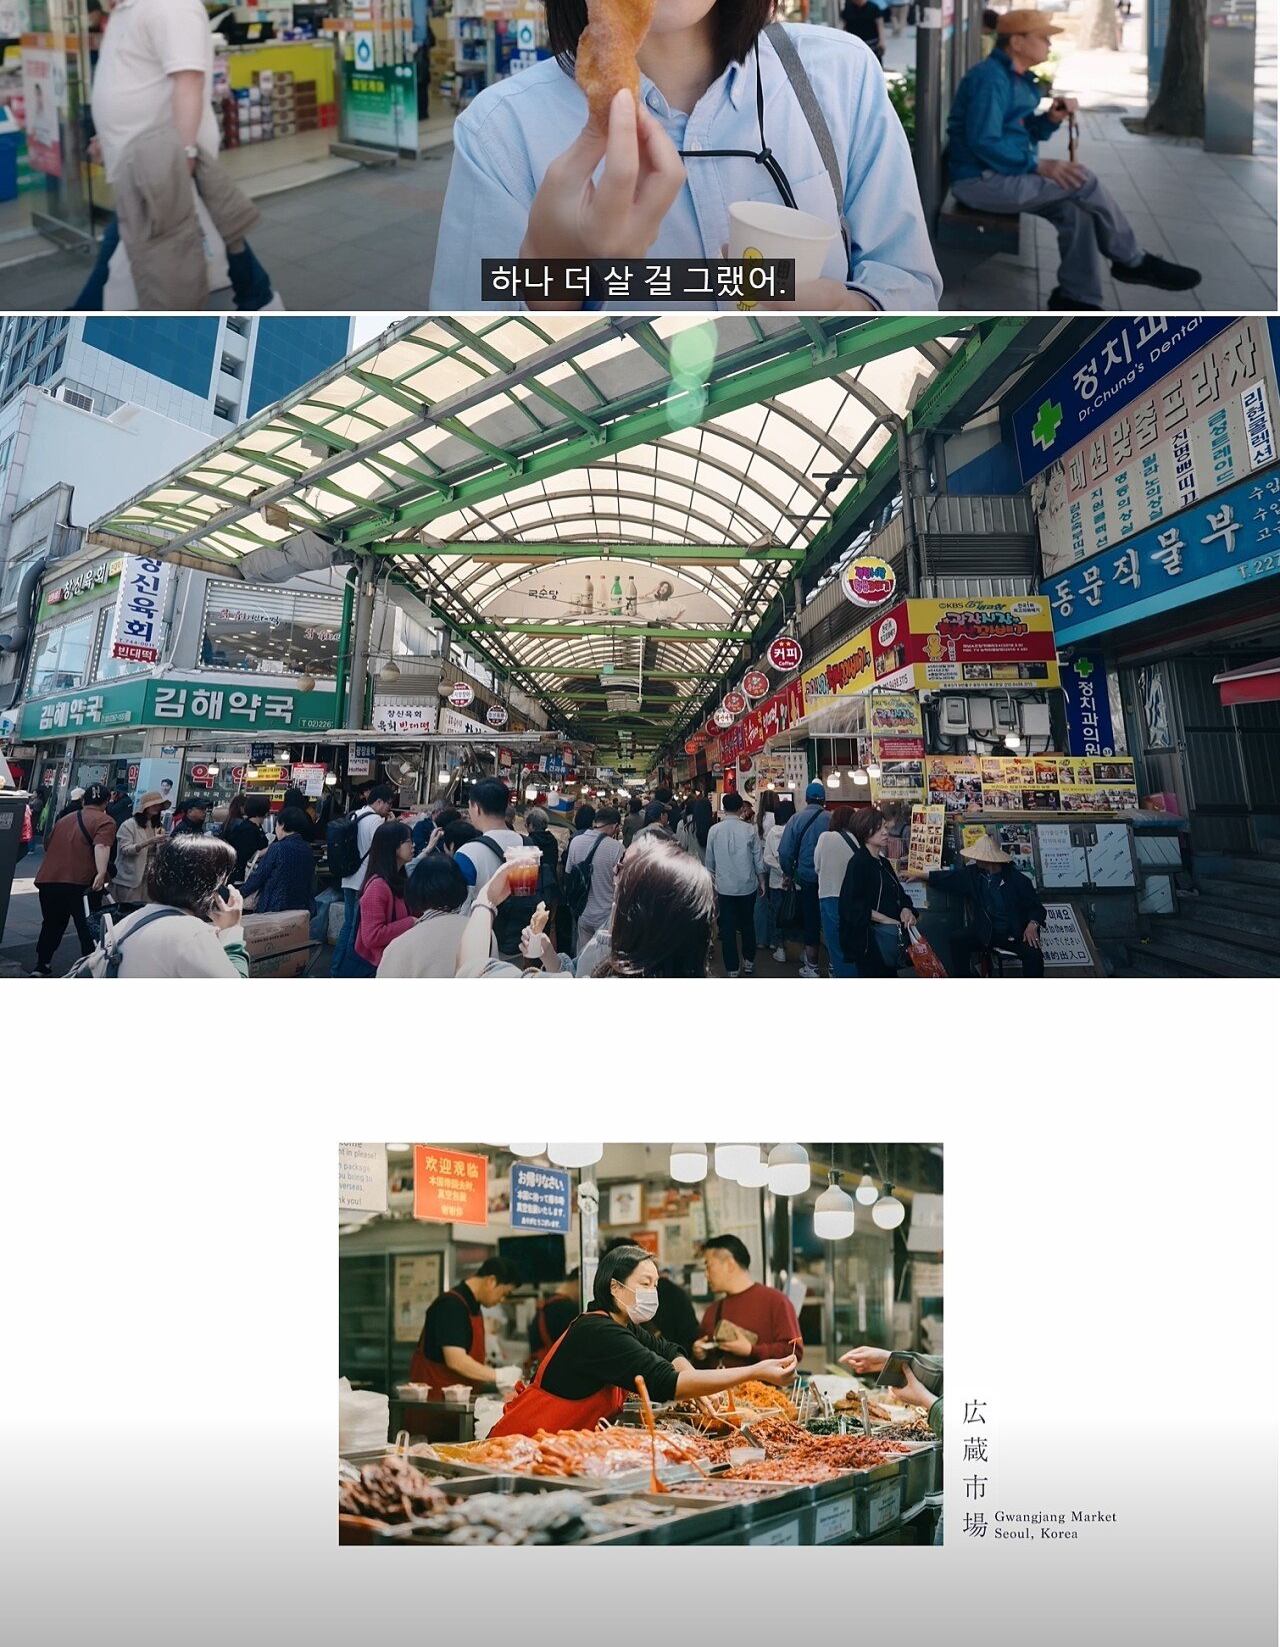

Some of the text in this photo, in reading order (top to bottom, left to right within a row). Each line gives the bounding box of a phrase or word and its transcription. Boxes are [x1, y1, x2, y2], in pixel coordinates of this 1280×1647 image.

[1078, 316, 1203, 421] Dr.Chung's Dental
[1069, 324, 1258, 492] 패션맞춤프라자
[1050, 504, 1243, 618] 동문직물부
[62, 562, 108, 601] 창신육회
[527, 586, 560, 601] 국순당
[117, 645, 154, 661] 빈대떡
[773, 646, 799, 661] 커피
[39, 695, 104, 731] 김해약국
[154, 687, 295, 724] 김해약국
[386, 708, 422, 719] 창신육회
[1078, 681, 1101, 757] 정치과의원
[307, 720, 334, 728] 02)226
[377, 720, 430, 733] 육회 빈대떡
